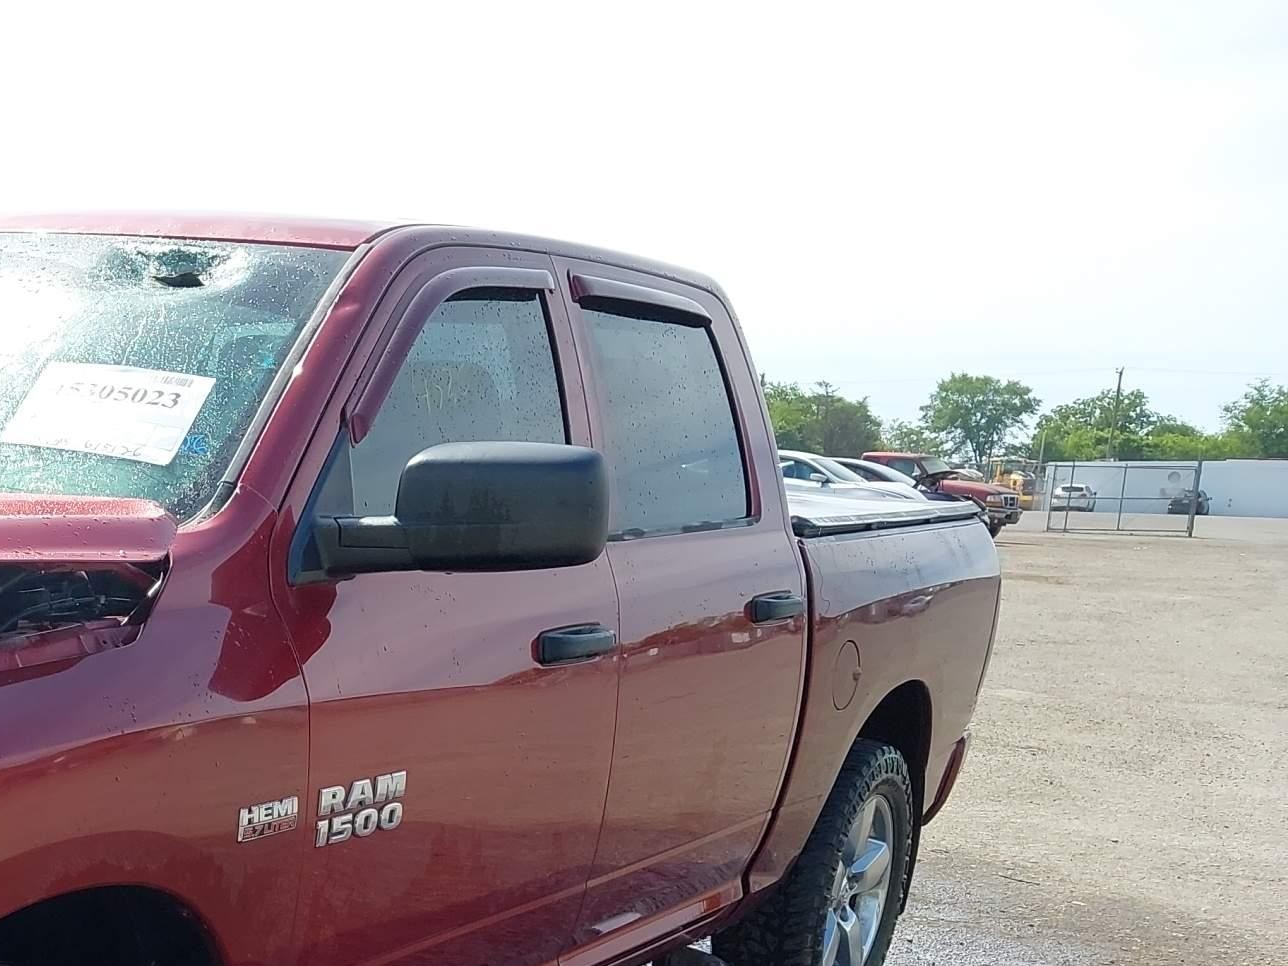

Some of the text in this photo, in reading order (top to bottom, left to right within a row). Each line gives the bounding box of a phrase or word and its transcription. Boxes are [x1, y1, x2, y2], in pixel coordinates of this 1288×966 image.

[241, 796, 299, 826] HEMI
[319, 770, 407, 816] RAM
[315, 802, 403, 848] 1500
